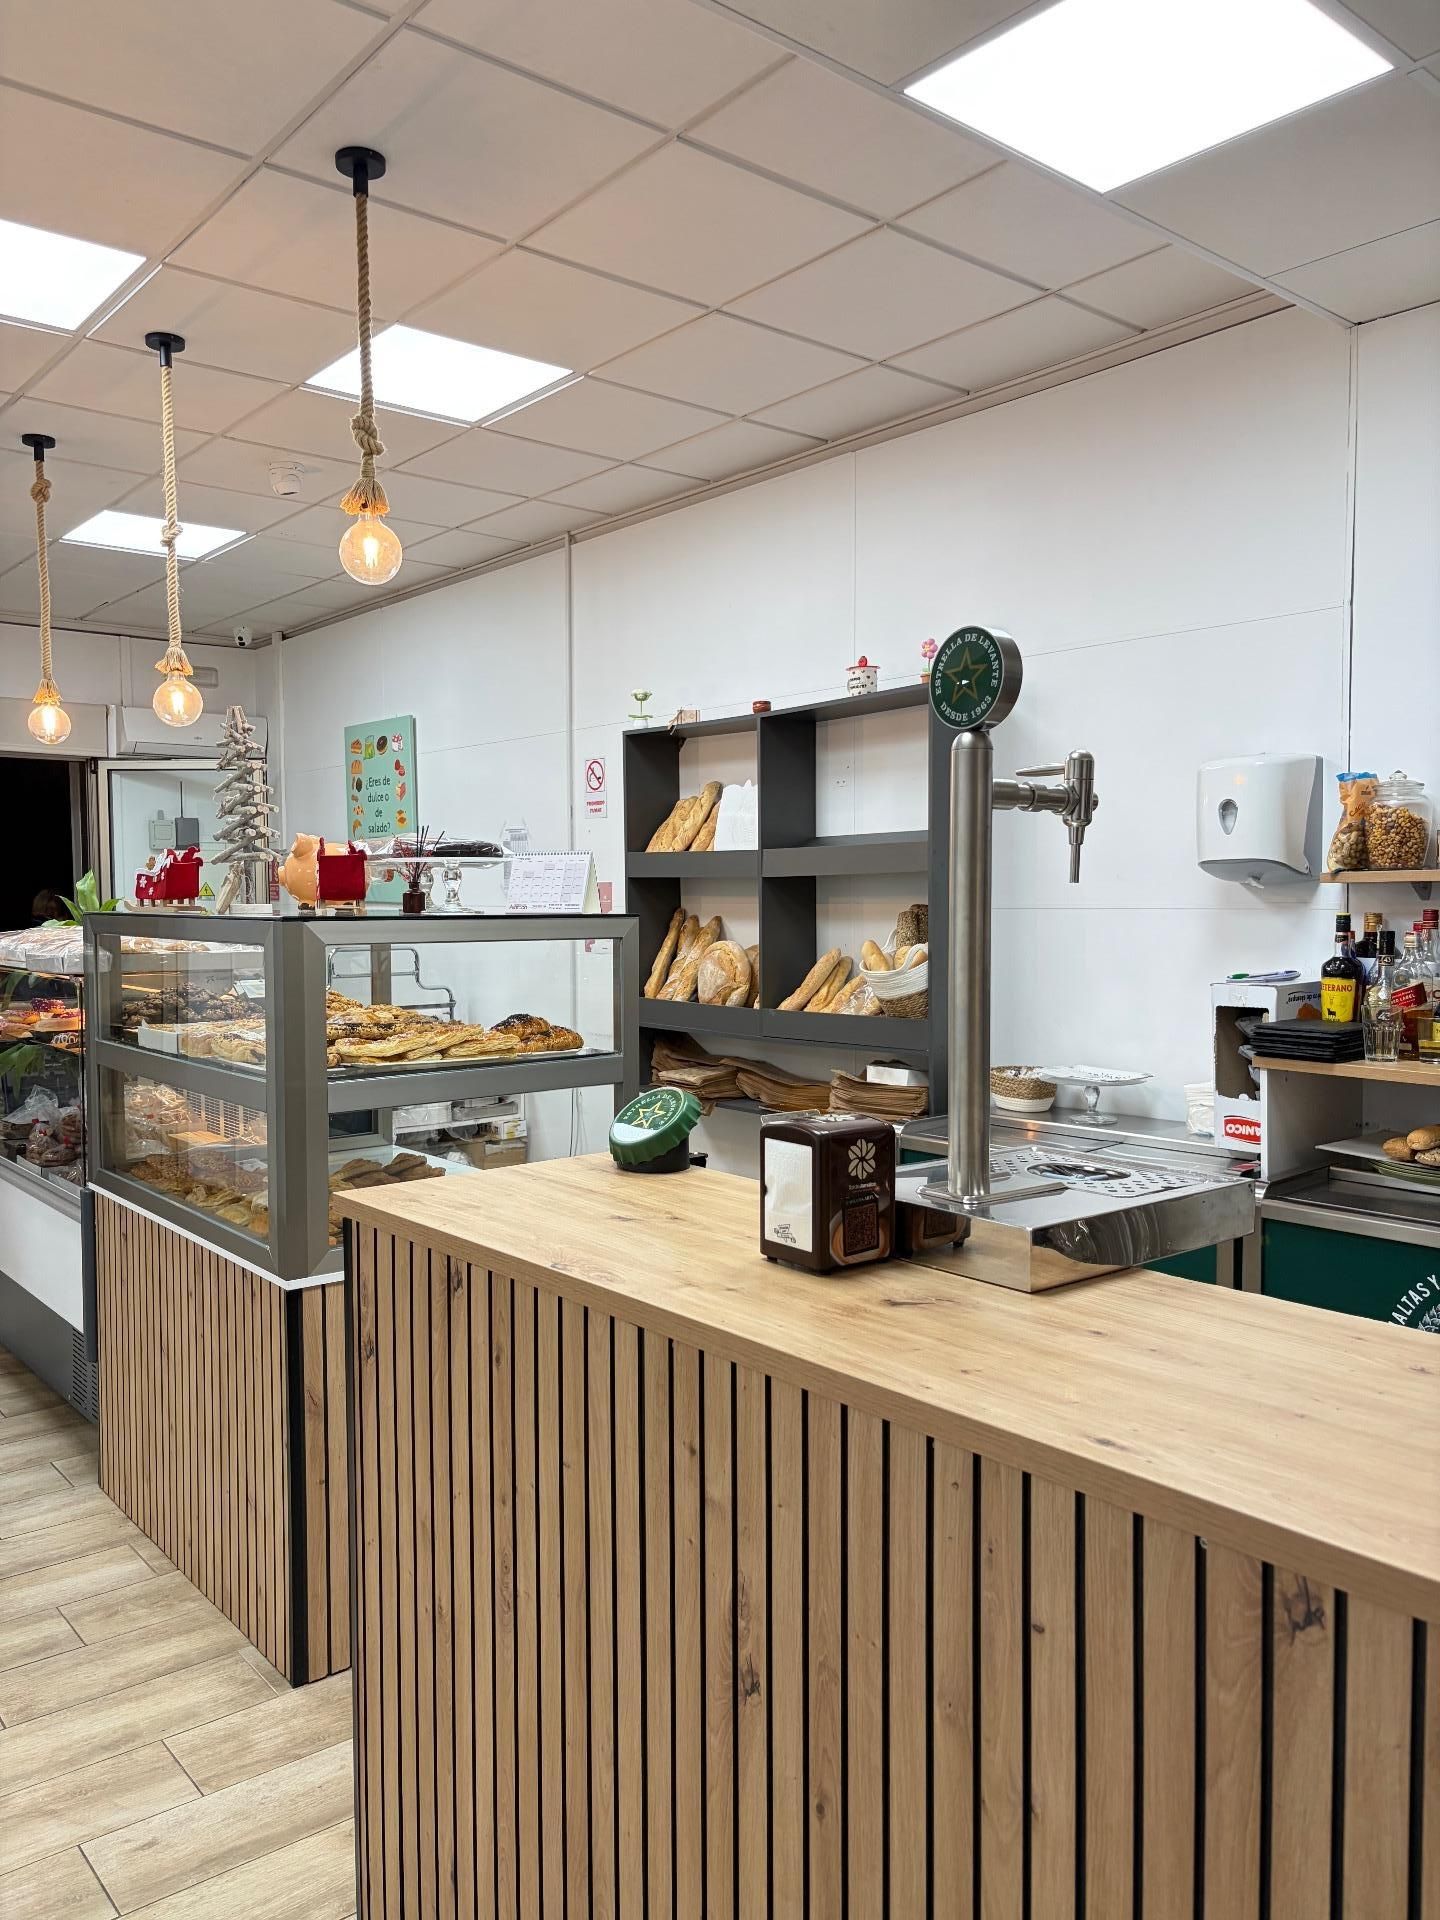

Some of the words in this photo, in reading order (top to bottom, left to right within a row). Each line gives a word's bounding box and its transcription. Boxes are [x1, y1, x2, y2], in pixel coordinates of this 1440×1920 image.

[935, 637, 962, 695] ESTRELLA
[965, 633, 978, 642] DE
[979, 635, 999, 688] LEVANTE
[940, 702, 968, 721] DESDE
[971, 695, 992, 718] 1963
[366, 777, 381, 790] ¿Eres
[383, 776, 391, 785] de
[368, 792, 384, 802] dulce
[375, 807, 383, 817] de
[368, 821, 391, 833] salado?
[1322, 983, 1352, 992] ETERANO
[1226, 1123, 1262, 1136] ANICO
[1387, 1282, 1431, 1326] ALTAS
[1426, 1274, 1440, 1291] Y
